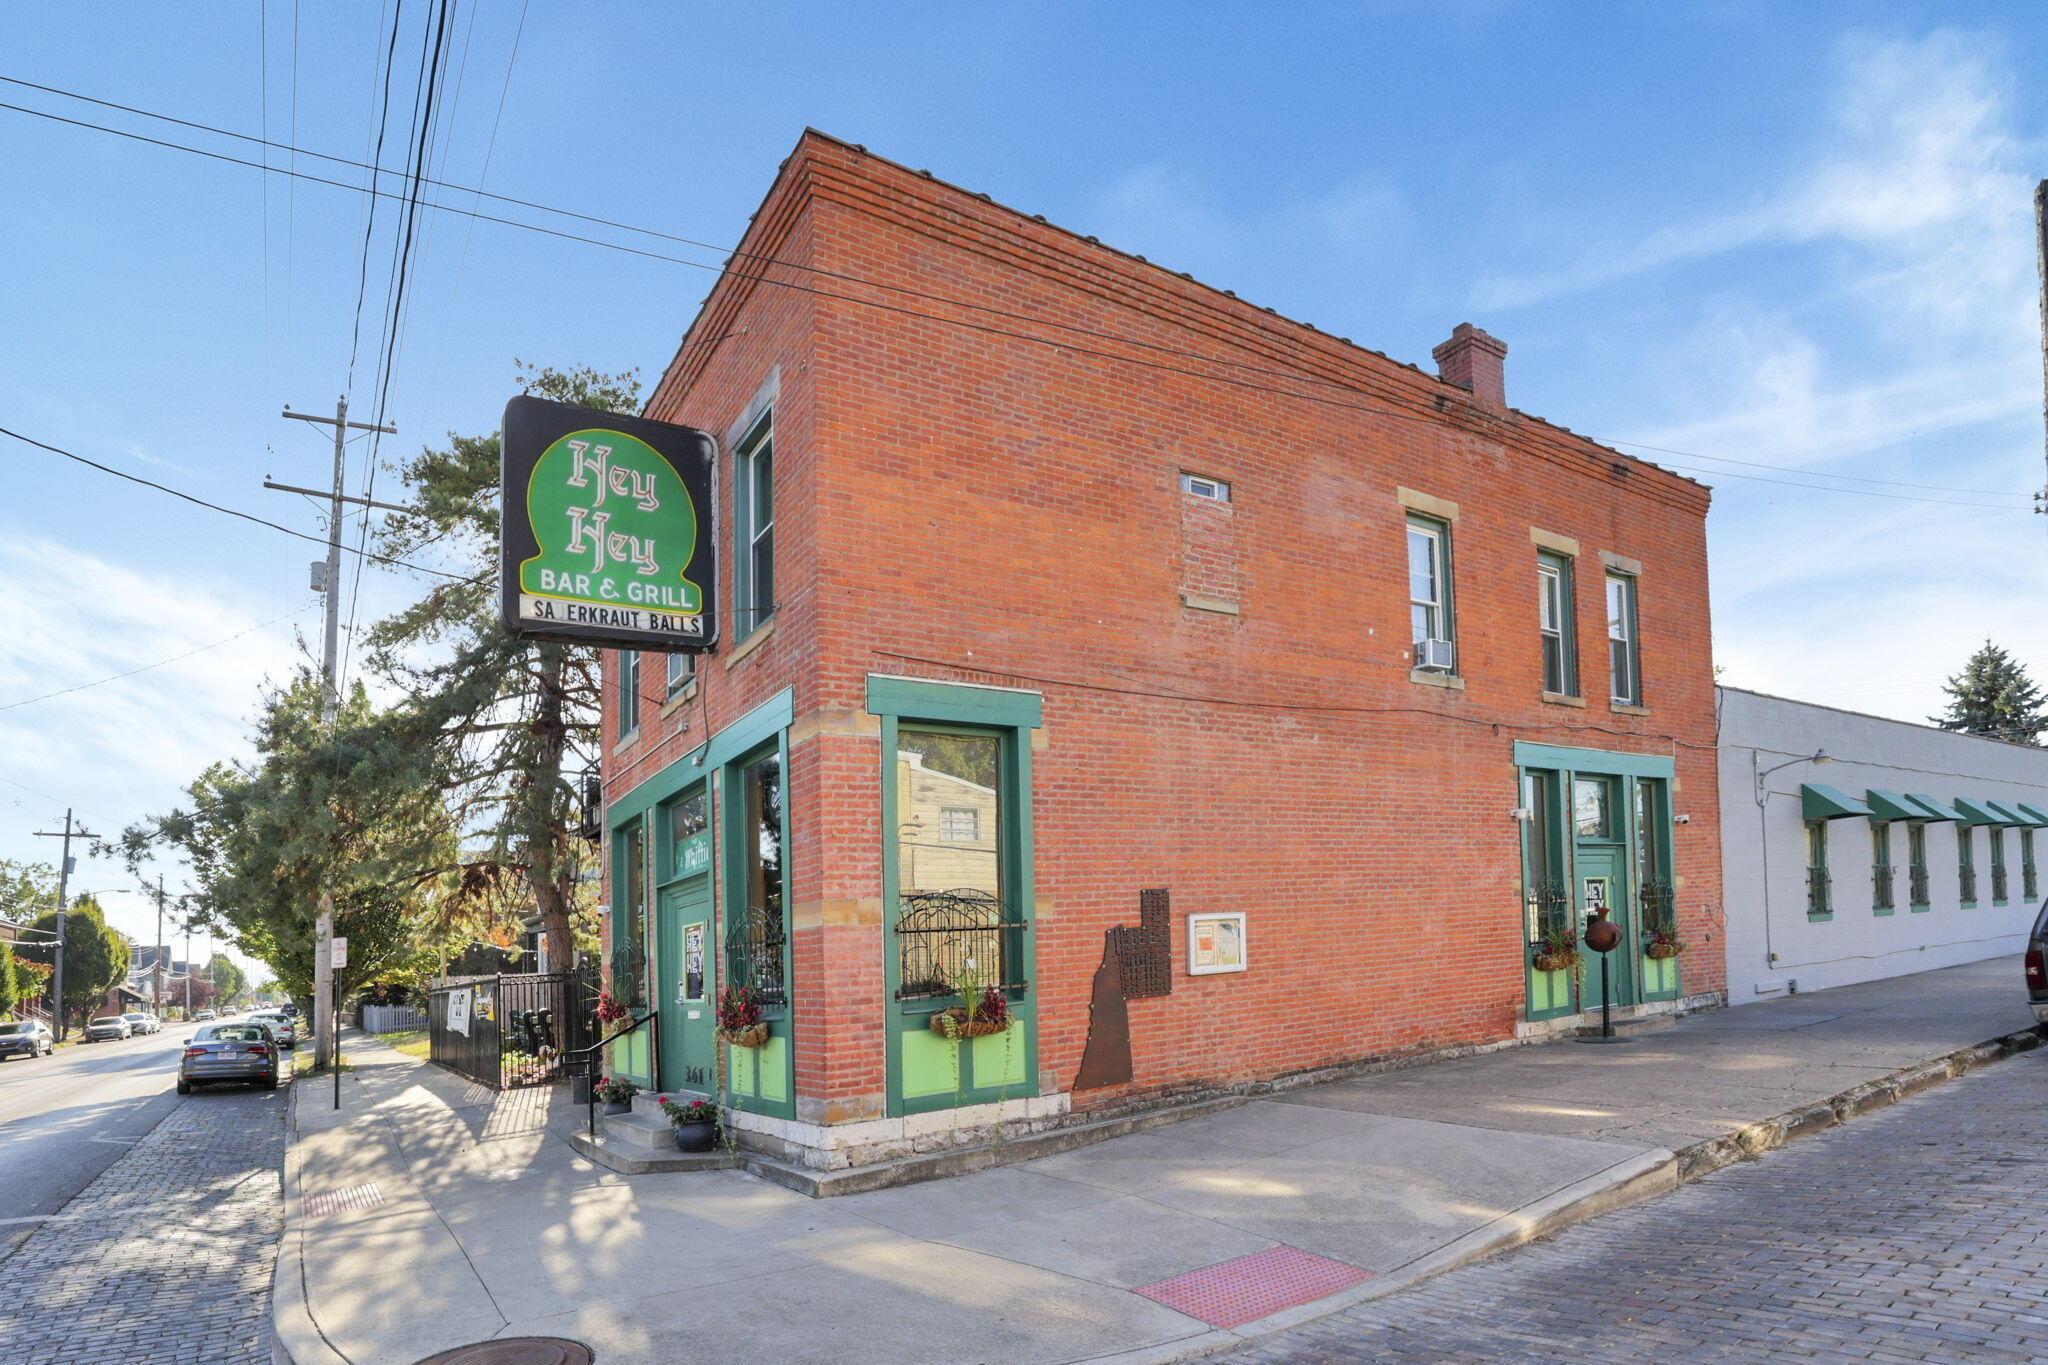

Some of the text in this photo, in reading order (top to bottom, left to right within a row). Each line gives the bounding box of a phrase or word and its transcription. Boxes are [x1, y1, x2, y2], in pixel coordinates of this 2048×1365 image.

[566, 439, 660, 512] Hey
[565, 506, 660, 576] Hey
[540, 568, 693, 609] BAR & GRILL
[650, 613, 699, 634] BALLS
[1584, 883, 1604, 899] HEY
